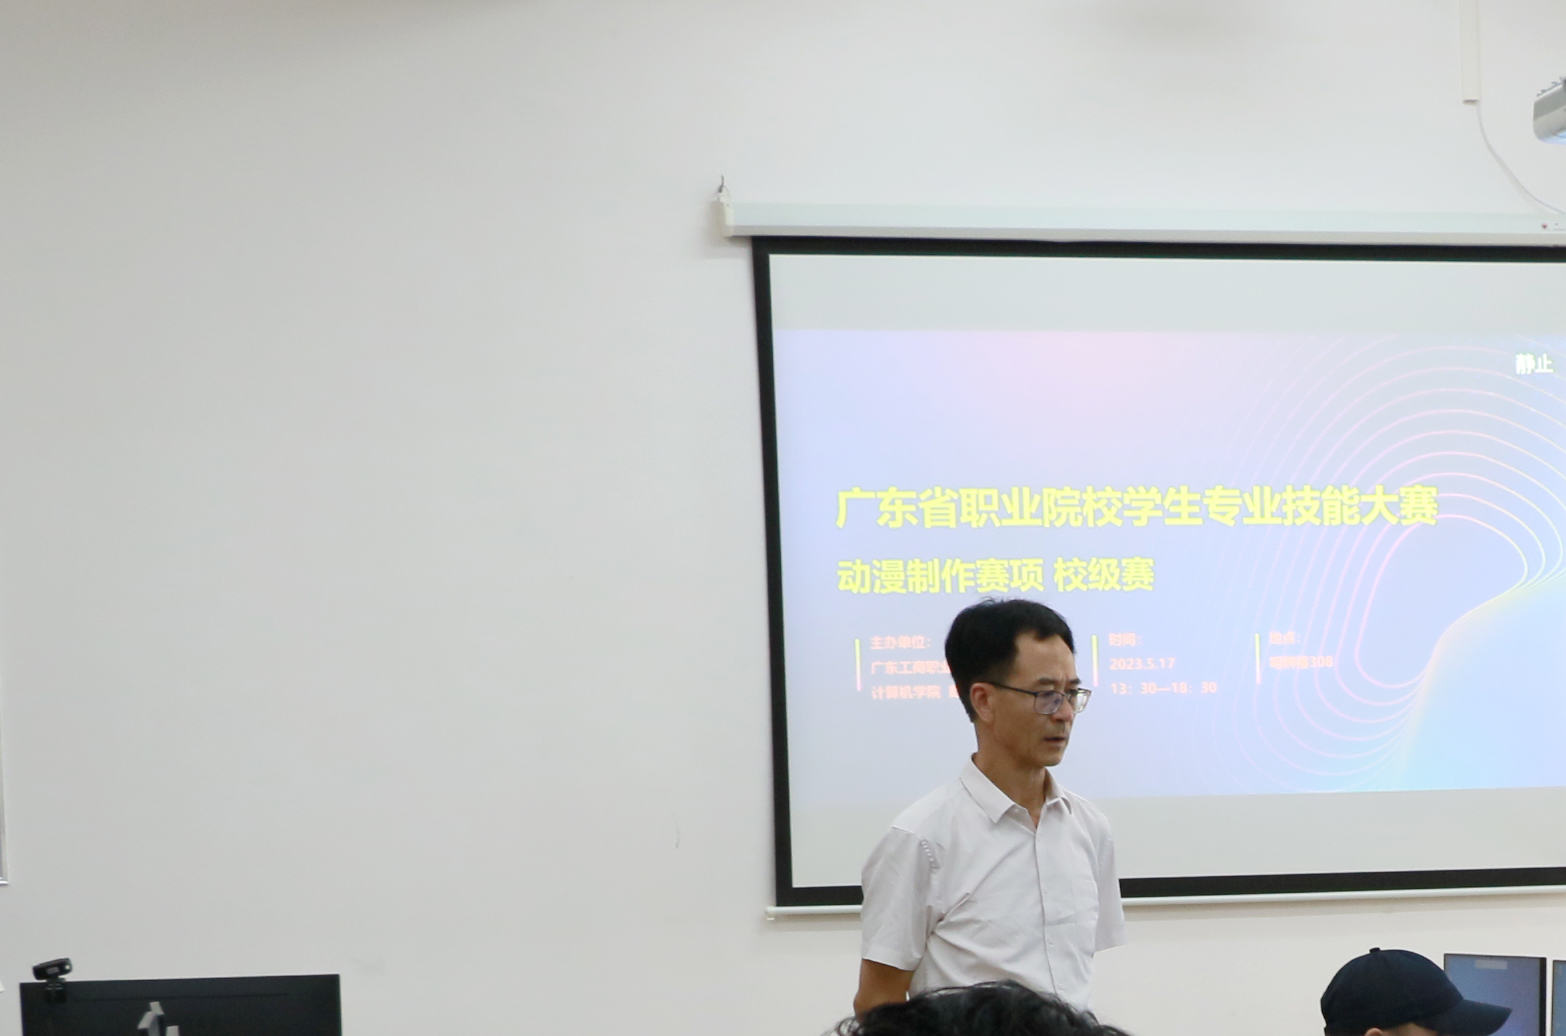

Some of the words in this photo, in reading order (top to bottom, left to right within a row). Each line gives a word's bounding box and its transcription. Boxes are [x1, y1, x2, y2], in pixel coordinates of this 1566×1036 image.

[1515, 353, 1554, 375] 静止
[835, 485, 1439, 529] 广东省职业院校学生专业技能大赛
[836, 558, 1044, 594] 动漫制作赛项
[1053, 557, 1155, 592] 校级赛
[1109, 657, 1176, 670] 2023.5.17
